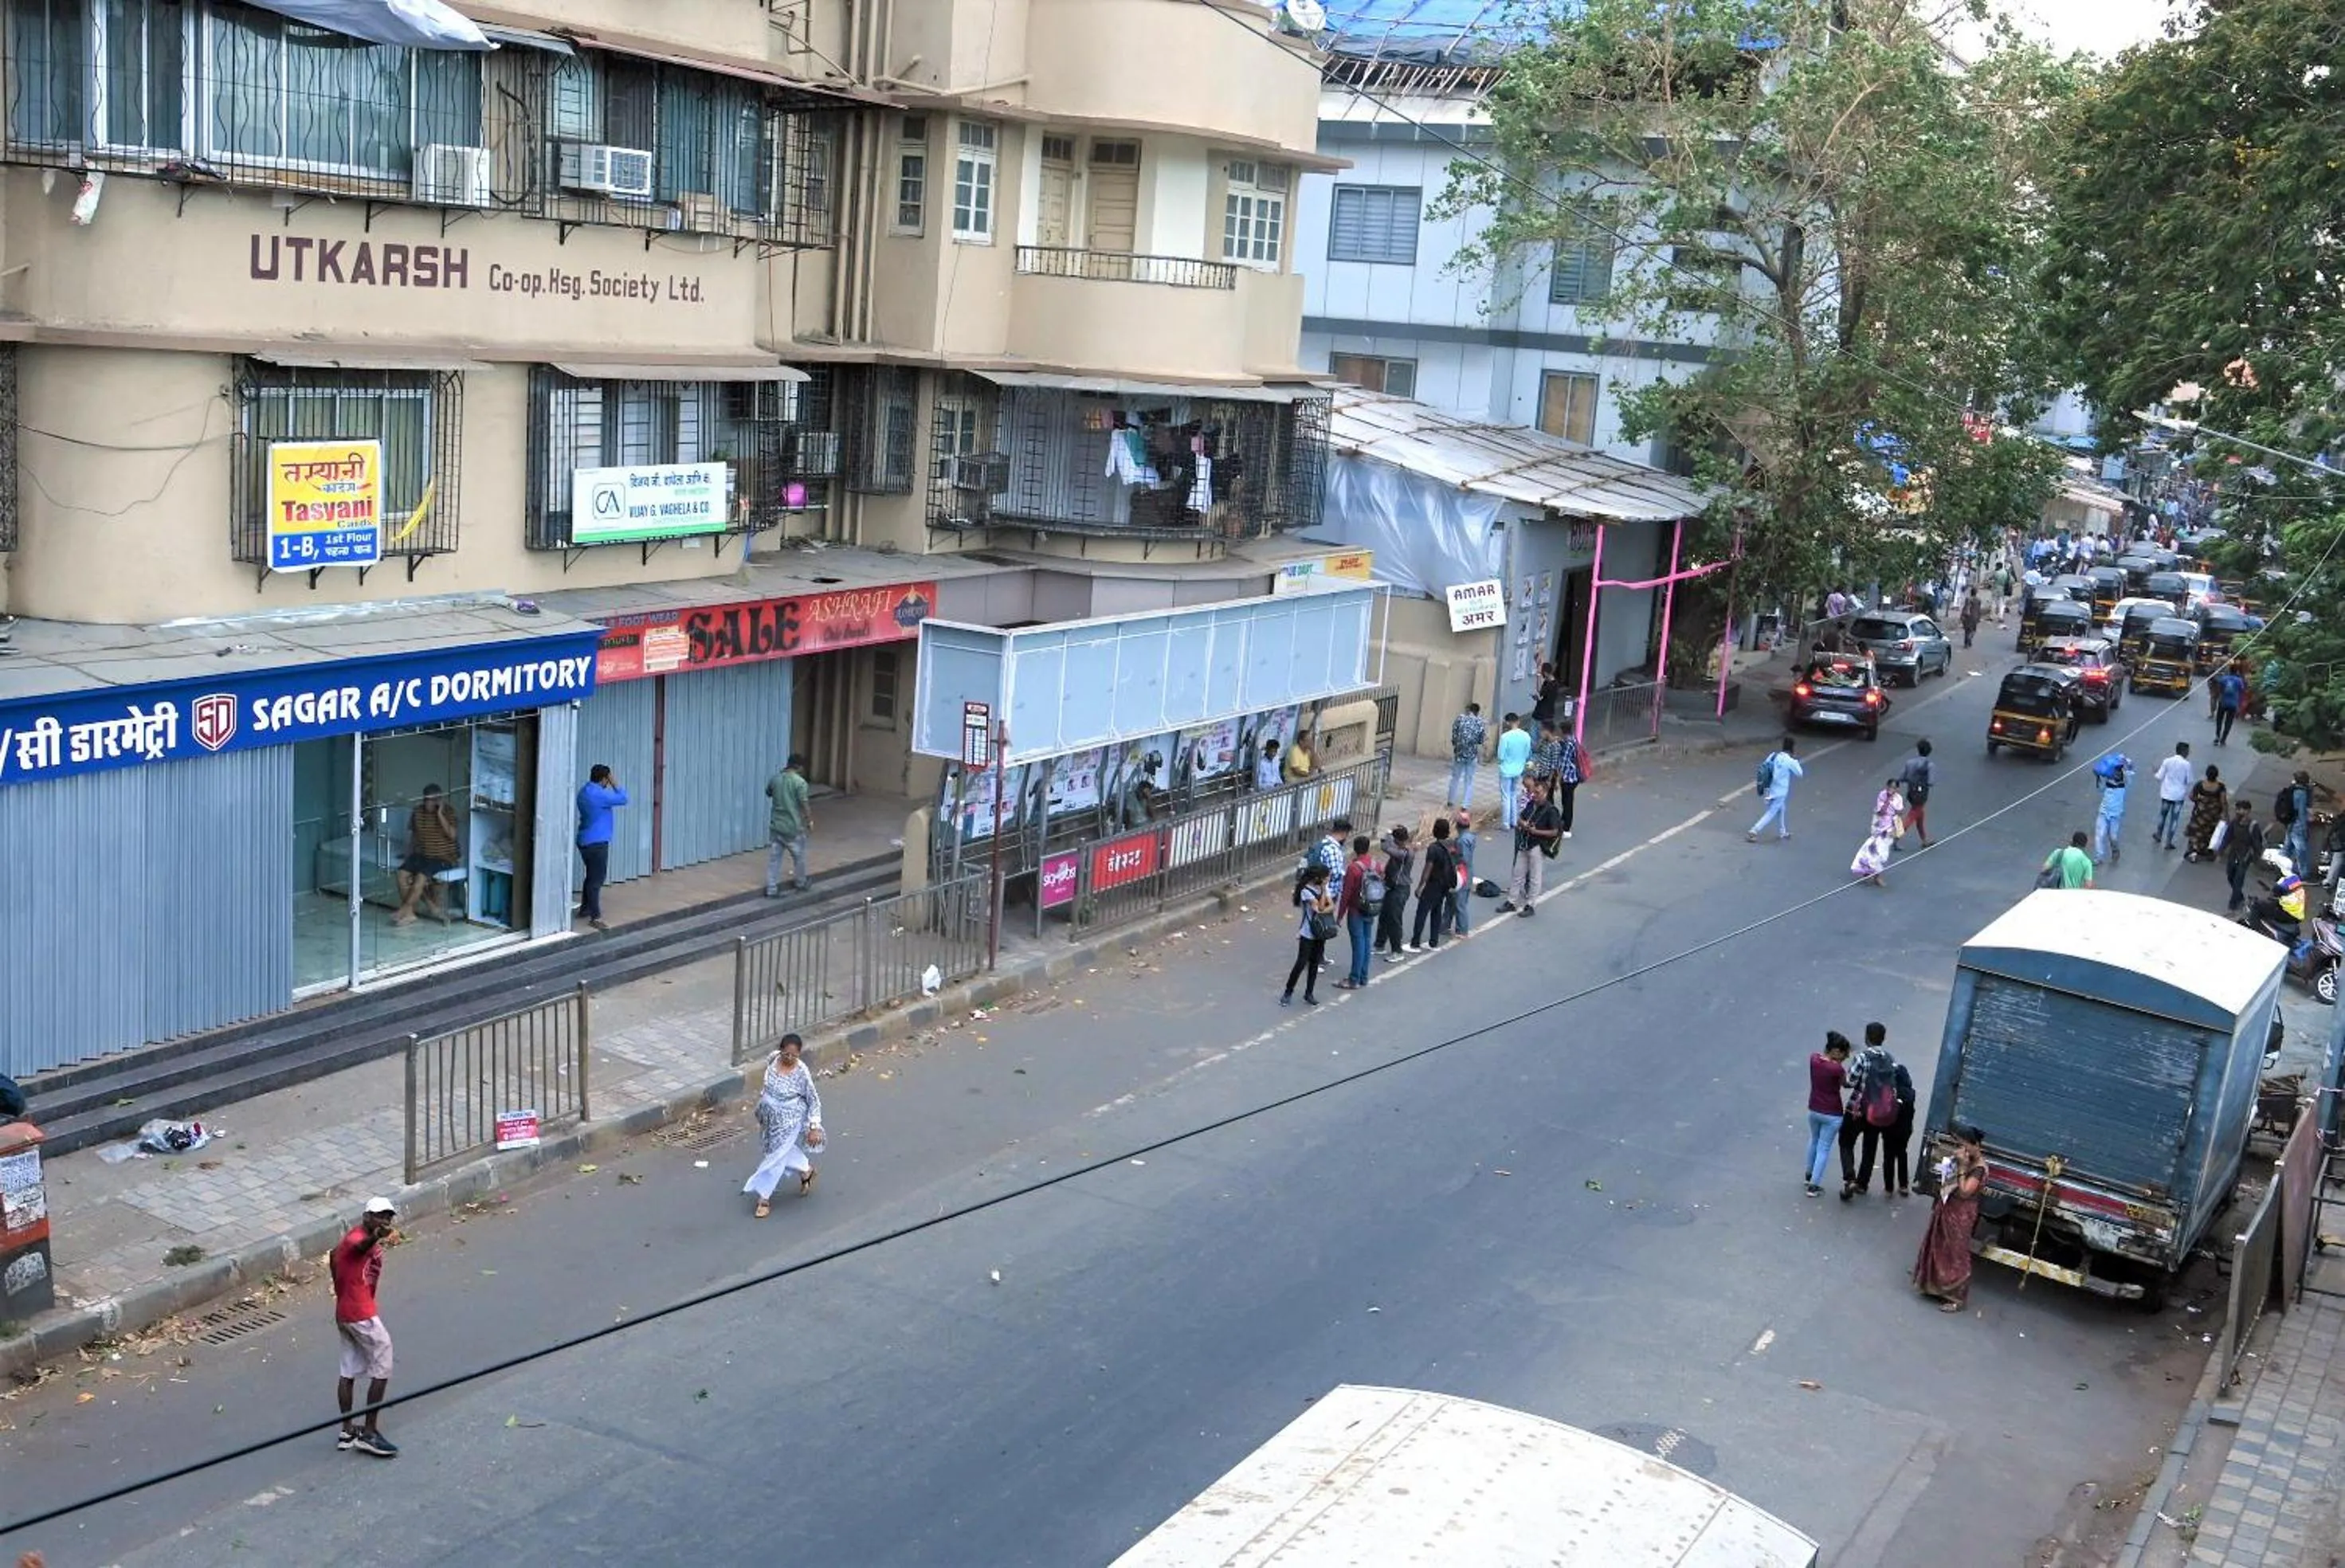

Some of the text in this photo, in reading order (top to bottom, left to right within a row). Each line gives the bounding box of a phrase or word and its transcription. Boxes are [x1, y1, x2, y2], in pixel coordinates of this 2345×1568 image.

[250, 234, 469, 288] UTKARSH
[669, 275, 705, 303] Ltd.
[281, 496, 373, 521] Tasyani
[659, 502, 692, 515] VAGHELA
[325, 534, 343, 545] 1st
[1454, 584, 1495, 600] AMAR
[618, 614, 645, 626] FOOT
[649, 611, 679, 624] WEAR
[1462, 611, 1494, 625] अमर
[687, 602, 800, 663] SALE
[252, 655, 593, 732] SAGAR A/C DORMITORY
